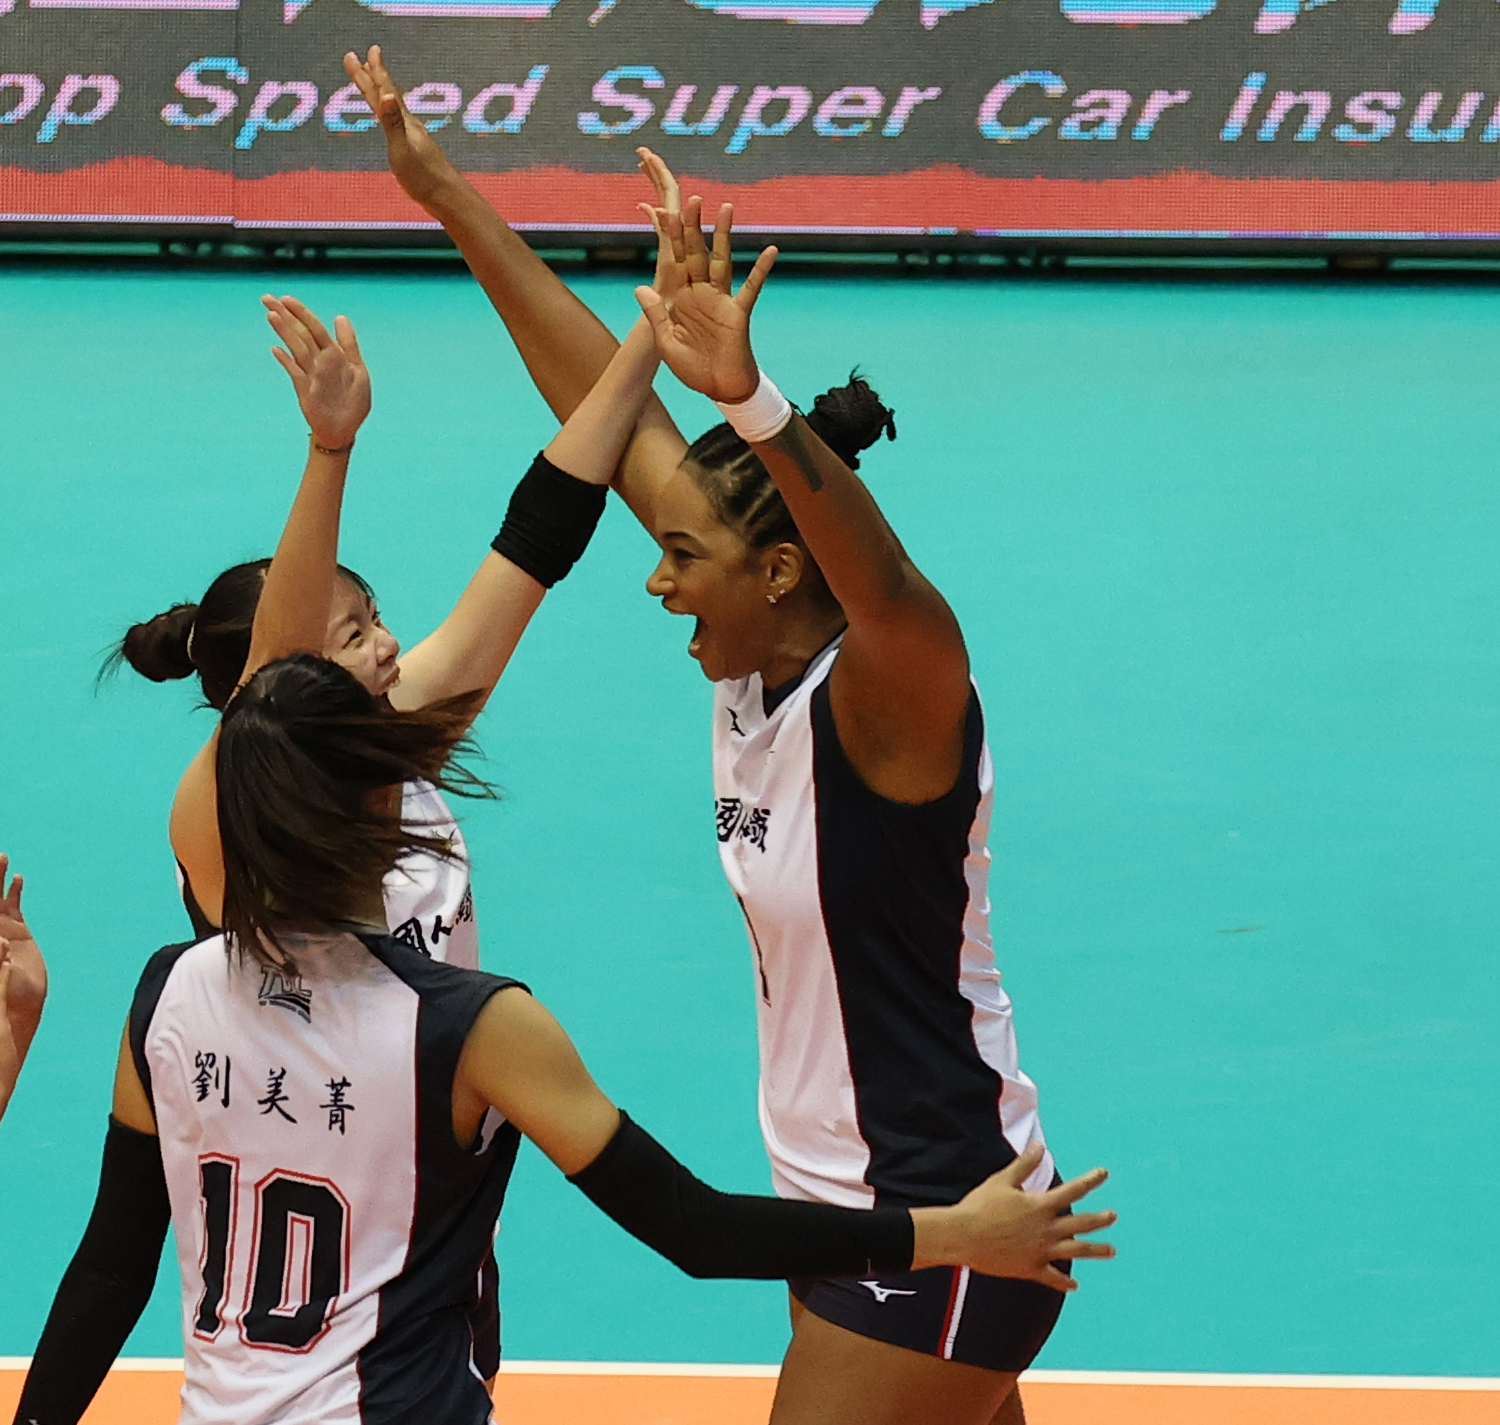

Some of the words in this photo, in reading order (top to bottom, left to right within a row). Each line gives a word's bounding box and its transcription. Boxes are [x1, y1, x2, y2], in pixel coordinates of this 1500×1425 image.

[161, 56, 550, 150] Speed
[577, 65, 942, 154] Super
[977, 69, 1190, 142] Car
[192, 1050, 355, 1136] 劉美菁
[192, 1152, 351, 1354] 10
